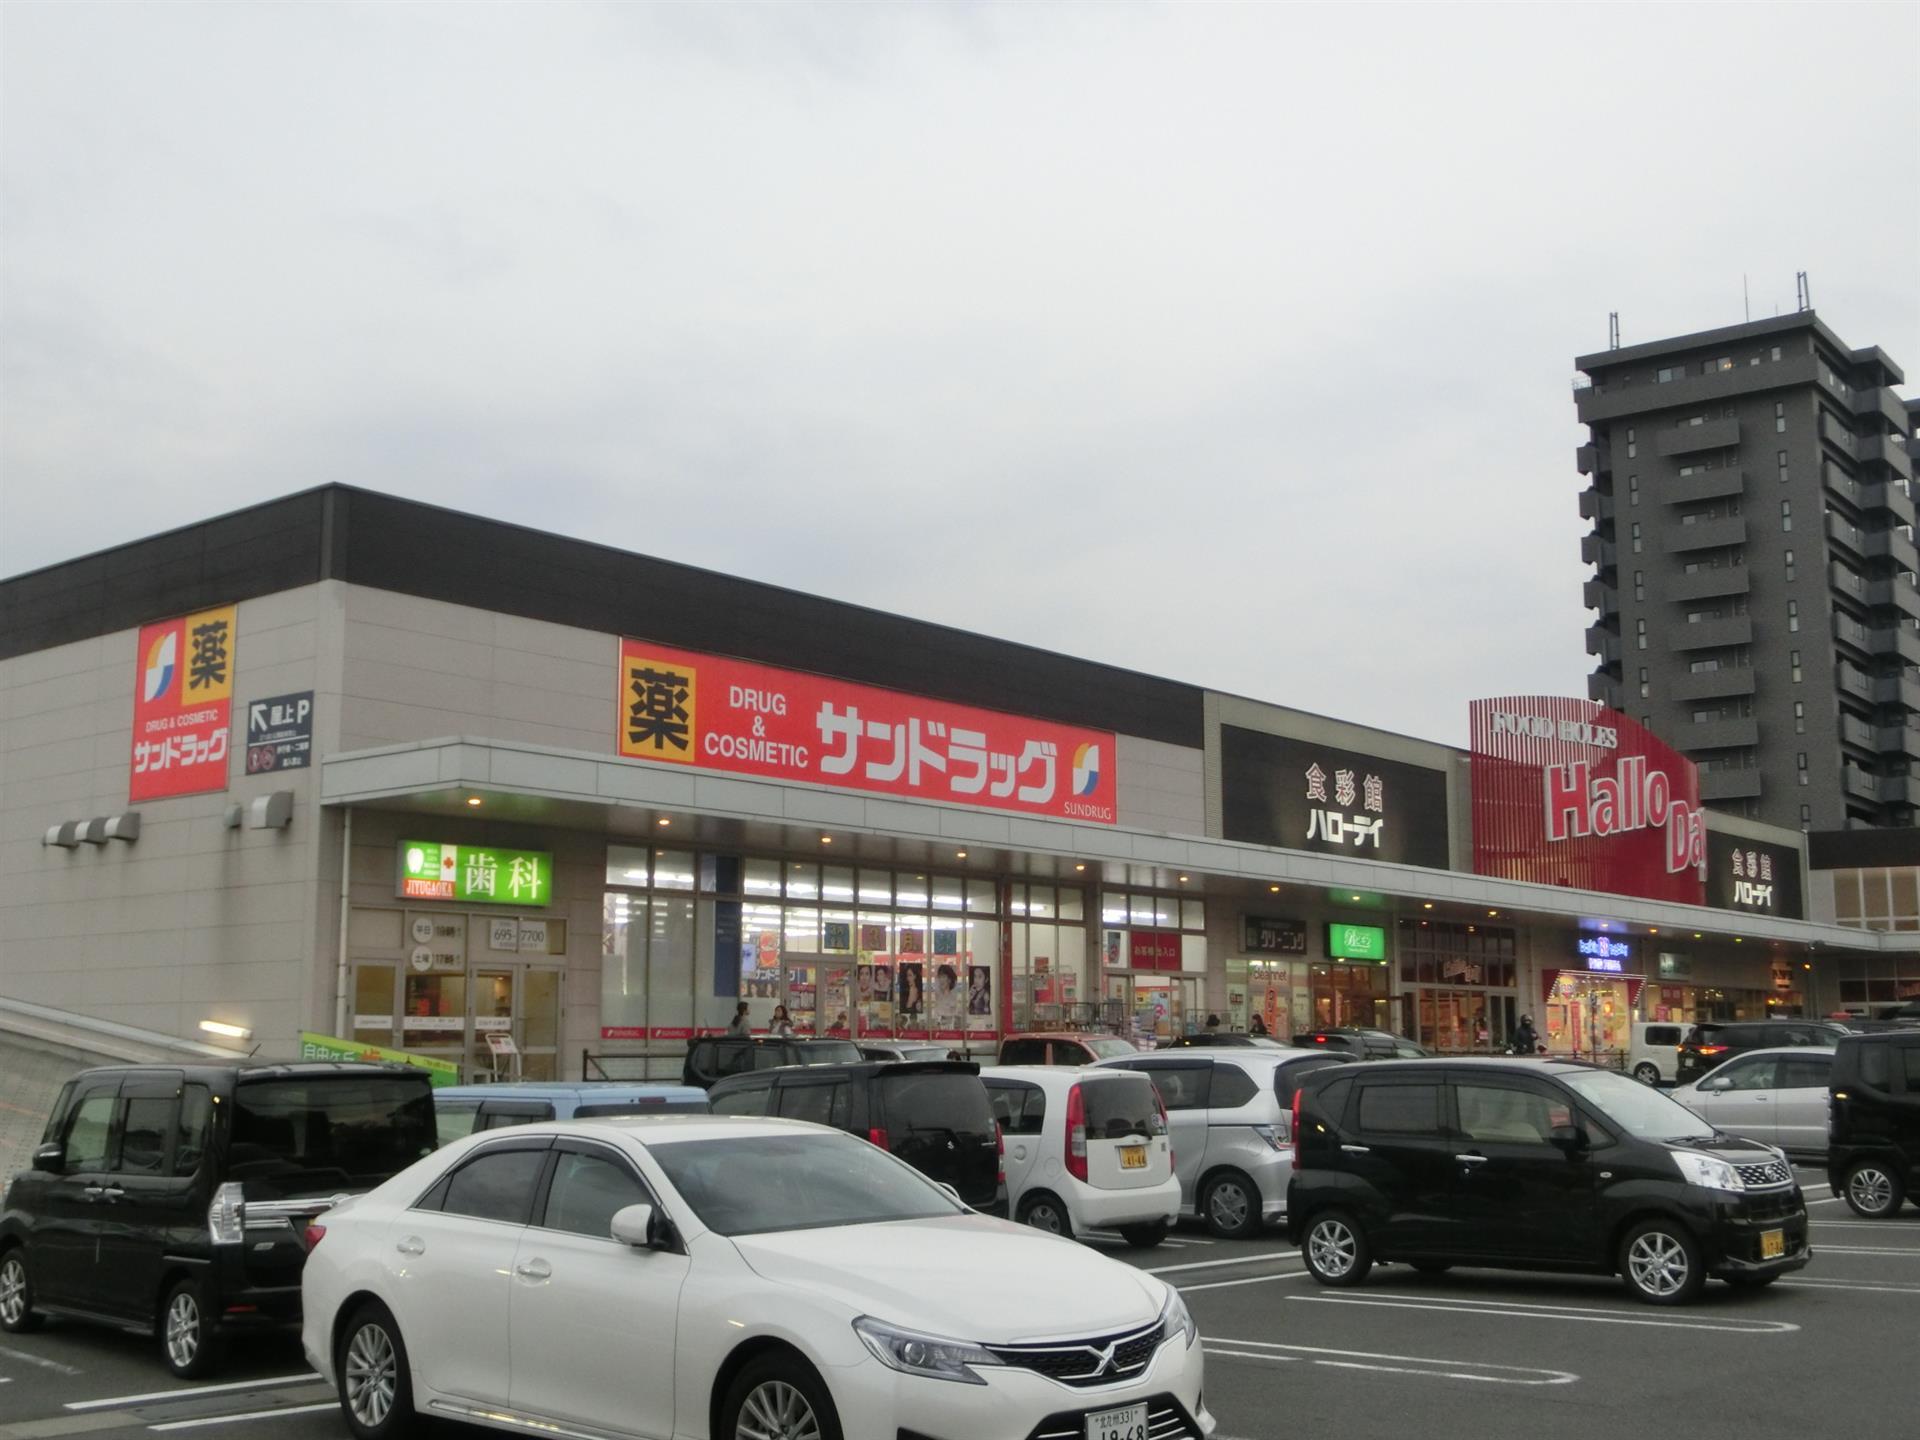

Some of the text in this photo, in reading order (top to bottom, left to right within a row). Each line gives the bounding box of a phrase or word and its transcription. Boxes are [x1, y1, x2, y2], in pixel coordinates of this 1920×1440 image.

[189, 621, 228, 689] 薬
[146, 709, 218, 732] DRUG & COSMETIC
[628, 667, 690, 751] 薬
[729, 686, 786, 716] DRUG
[752, 716, 766, 737] &
[1490, 711, 1554, 739] FOOD
[135, 728, 227, 773] サンドラッグ
[704, 732, 809, 768] COSMETIC
[816, 701, 1058, 804] サンドラッグ
[1305, 762, 1383, 812] 食彩館
[1544, 756, 1670, 842] Hallo
[1064, 801, 1112, 820] SUNDRUG
[1667, 800, 1707, 882] Da
[464, 853, 543, 899] 歯科
[1261, 928, 1304, 949] クリーニング
